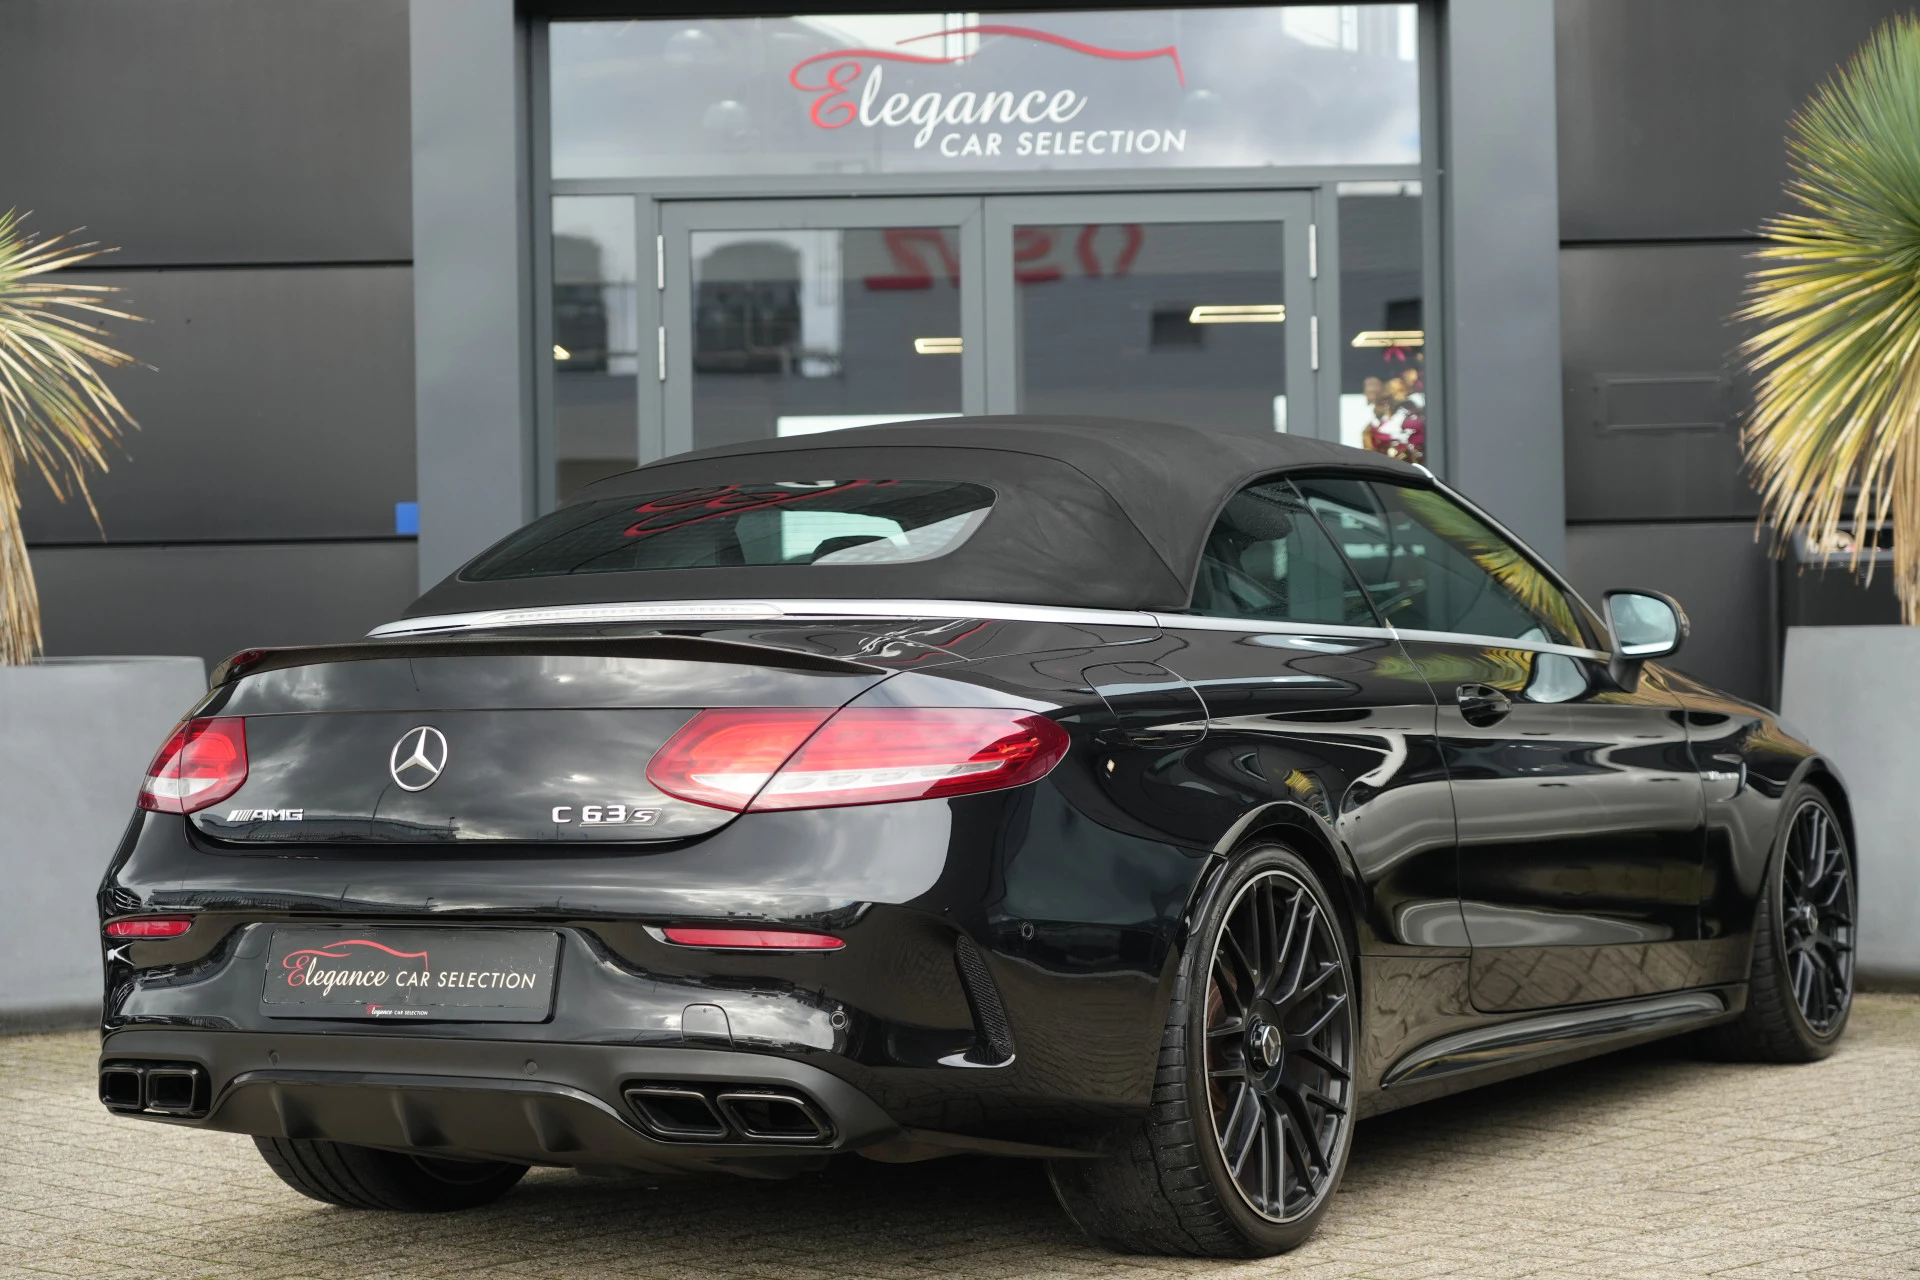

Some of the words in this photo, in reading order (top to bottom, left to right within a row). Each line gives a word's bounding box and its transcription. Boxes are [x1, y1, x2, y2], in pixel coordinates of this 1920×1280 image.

[790, 50, 1087, 149] Elegance
[939, 132, 1002, 158] CAR
[1015, 129, 1187, 156] SELECTION
[249, 808, 304, 821] AMG
[283, 950, 390, 997] Elegance
[395, 970, 429, 988] CAR
[437, 971, 537, 989] SELECTION
